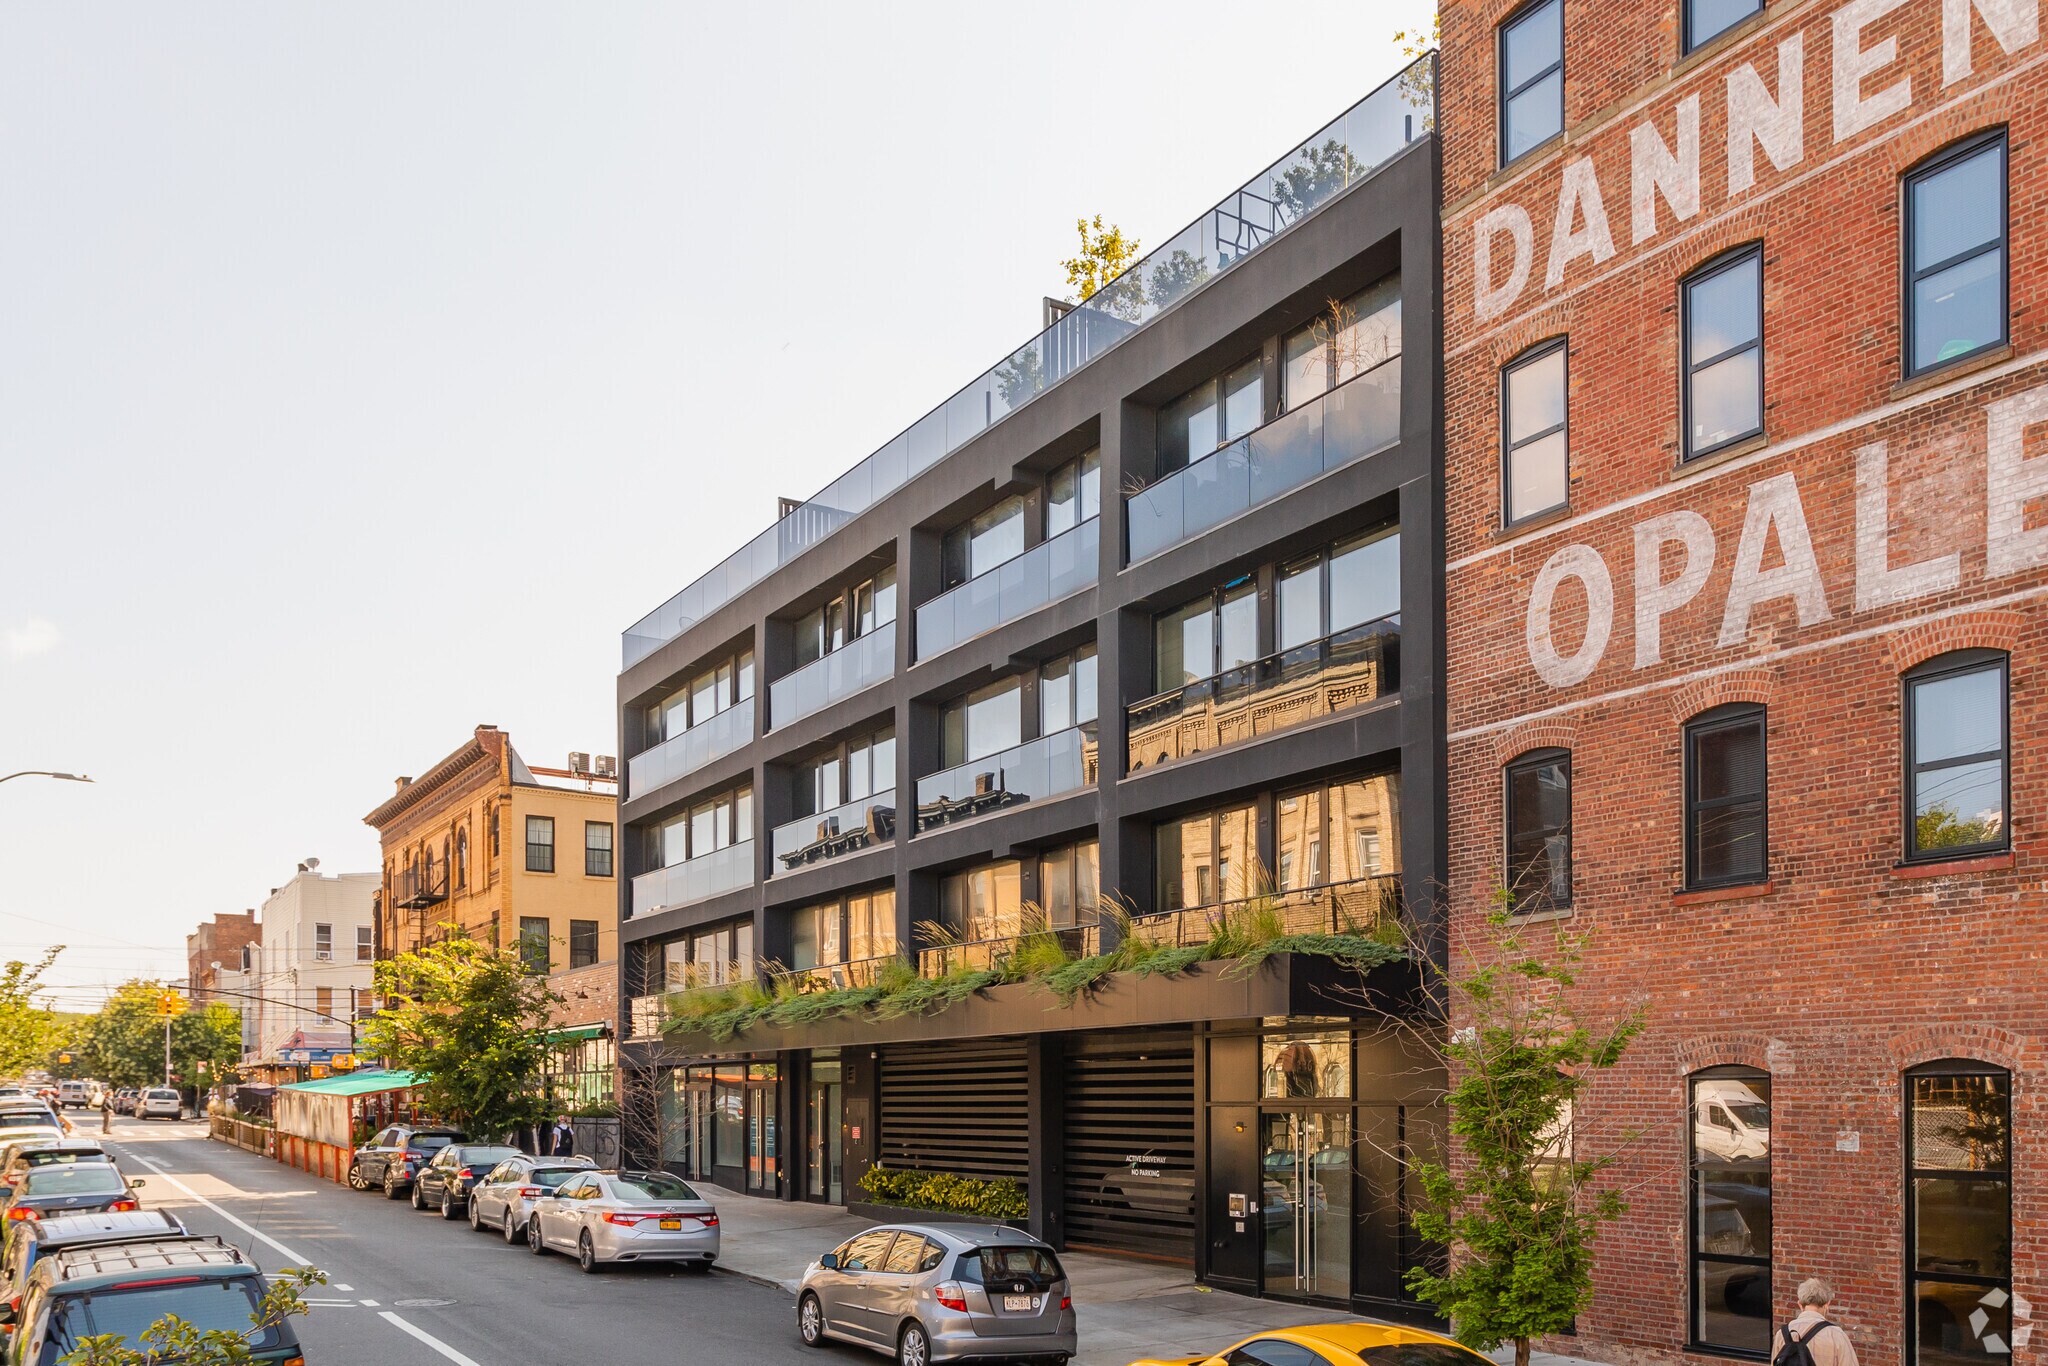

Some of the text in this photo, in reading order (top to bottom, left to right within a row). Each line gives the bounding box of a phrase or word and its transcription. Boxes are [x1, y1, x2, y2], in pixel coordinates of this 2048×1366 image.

[1126, 1155, 1167, 1164] ACTIVE DRIVEWAY
[1140, 1169, 1160, 1178] PARKING
